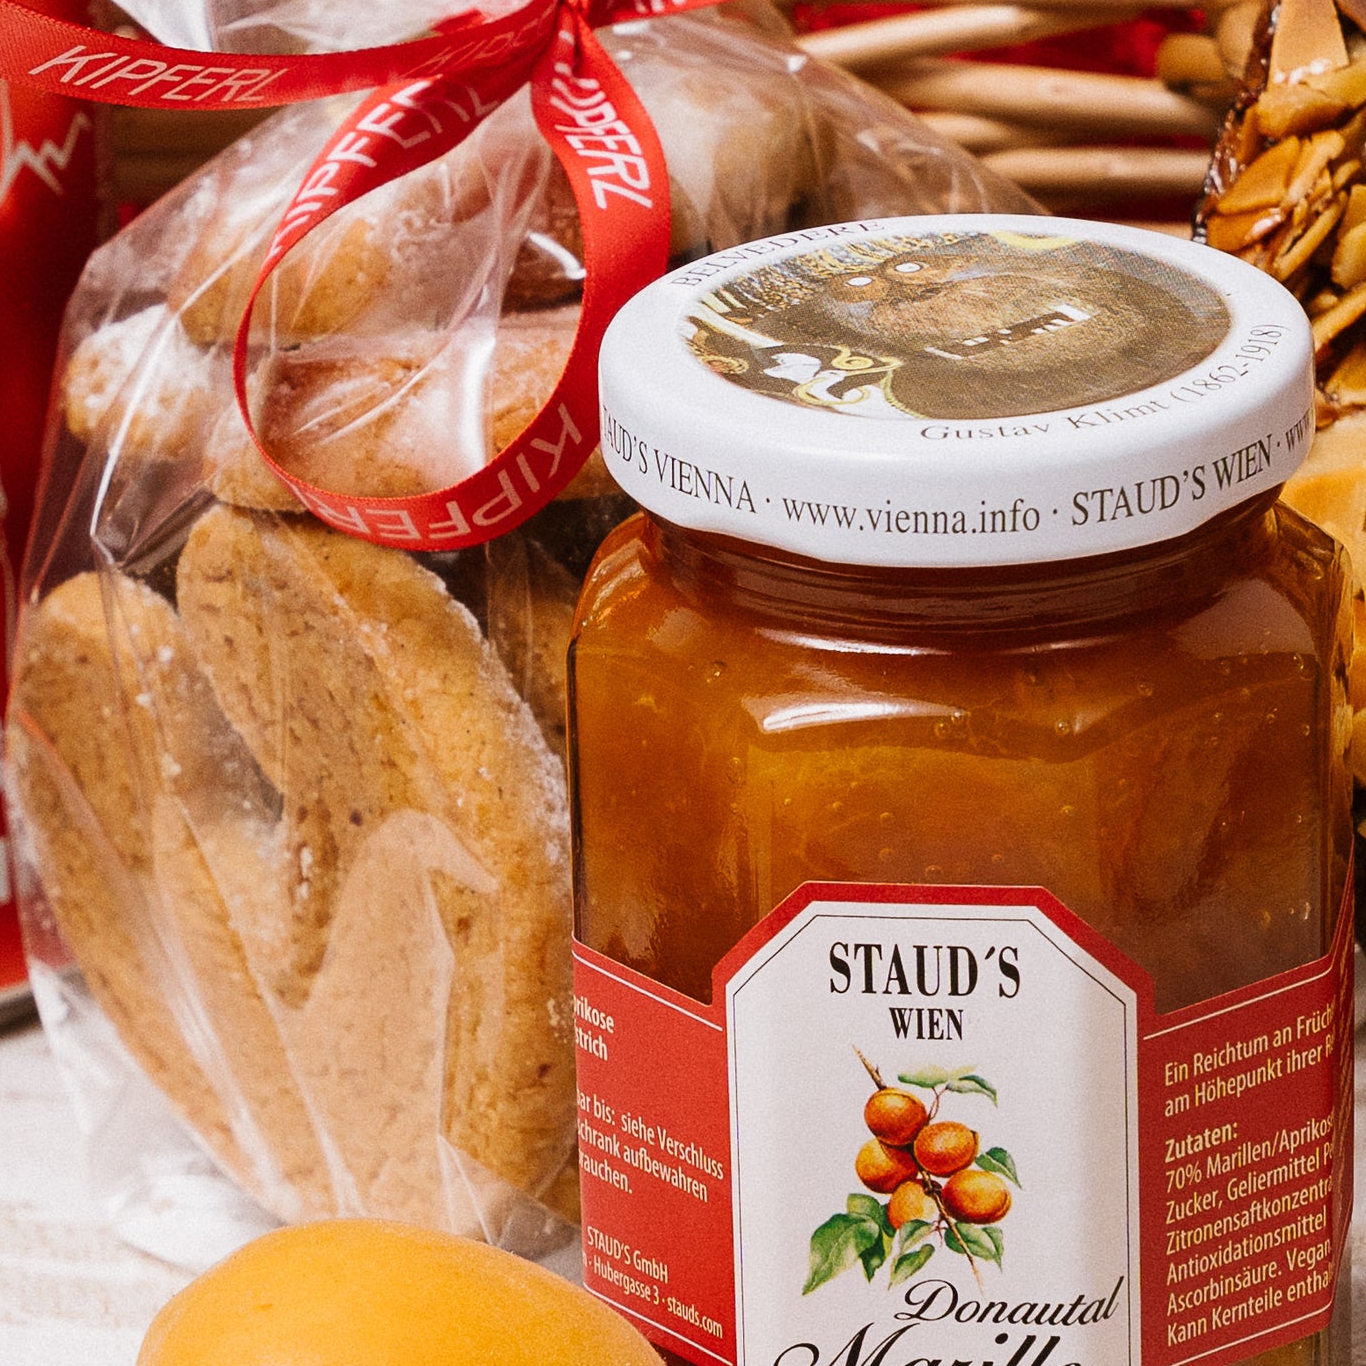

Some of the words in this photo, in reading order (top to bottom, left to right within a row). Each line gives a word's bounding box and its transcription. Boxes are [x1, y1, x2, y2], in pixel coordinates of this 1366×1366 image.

[29, 44, 289, 103] KIPFERL
[671, 220, 885, 287] BELVEDERE
[920, 423, 1051, 440] Gustav
[1066, 400, 1170, 430] Klimt
[1169, 323, 1293, 403] (1862-1918)
[602, 404, 649, 475] TAUD'S
[653, 448, 757, 514] VIENNA
[782, 498, 1041, 534] www.vienna.info
[1071, 464, 1206, 526] STAUD'S
[1212, 433, 1273, 490] WIEN
[575, 1021, 608, 1061] strich
[888, 1006, 964, 1041] WIEN
[1165, 1061, 1189, 1087] Ein
[1193, 1034, 1269, 1077] Reichtum
[1272, 1026, 1293, 1048] an
[1296, 1001, 1335, 1040] Früch
[1164, 1093, 1190, 1118] am
[1194, 1058, 1283, 1108] Höhepunkt
[1286, 1044, 1323, 1075] ihrer
[593, 1094, 616, 1126] bis:
[621, 1113, 655, 1146] siehe
[656, 1125, 724, 1181] Verschluss
[1164, 1121, 1239, 1164] Zutaten:
[1165, 1161, 1203, 1194] 70%
[1206, 1113, 1334, 1179] Marillen/Aprikos
[623, 1144, 709, 1203] aufbewahren
[1165, 1191, 1223, 1225] Zucker,
[1226, 1147, 1320, 1202] Geliermittel
[1165, 1175, 1333, 1256] Zitronensaftkonzentra
[1166, 1204, 1328, 1286] Antioxidationsmittel
[593, 1255, 651, 1302] Hubergasse
[653, 1285, 660, 1306] 3
[667, 1296, 724, 1339] stauds.com
[632, 1250, 669, 1284] GmbH
[893, 1275, 1125, 1326] Donautal
[1166, 1260, 1283, 1317] Ascorbinsäure.
[1167, 1317, 1208, 1348] Kann
[1211, 1286, 1283, 1331] Kernteile
